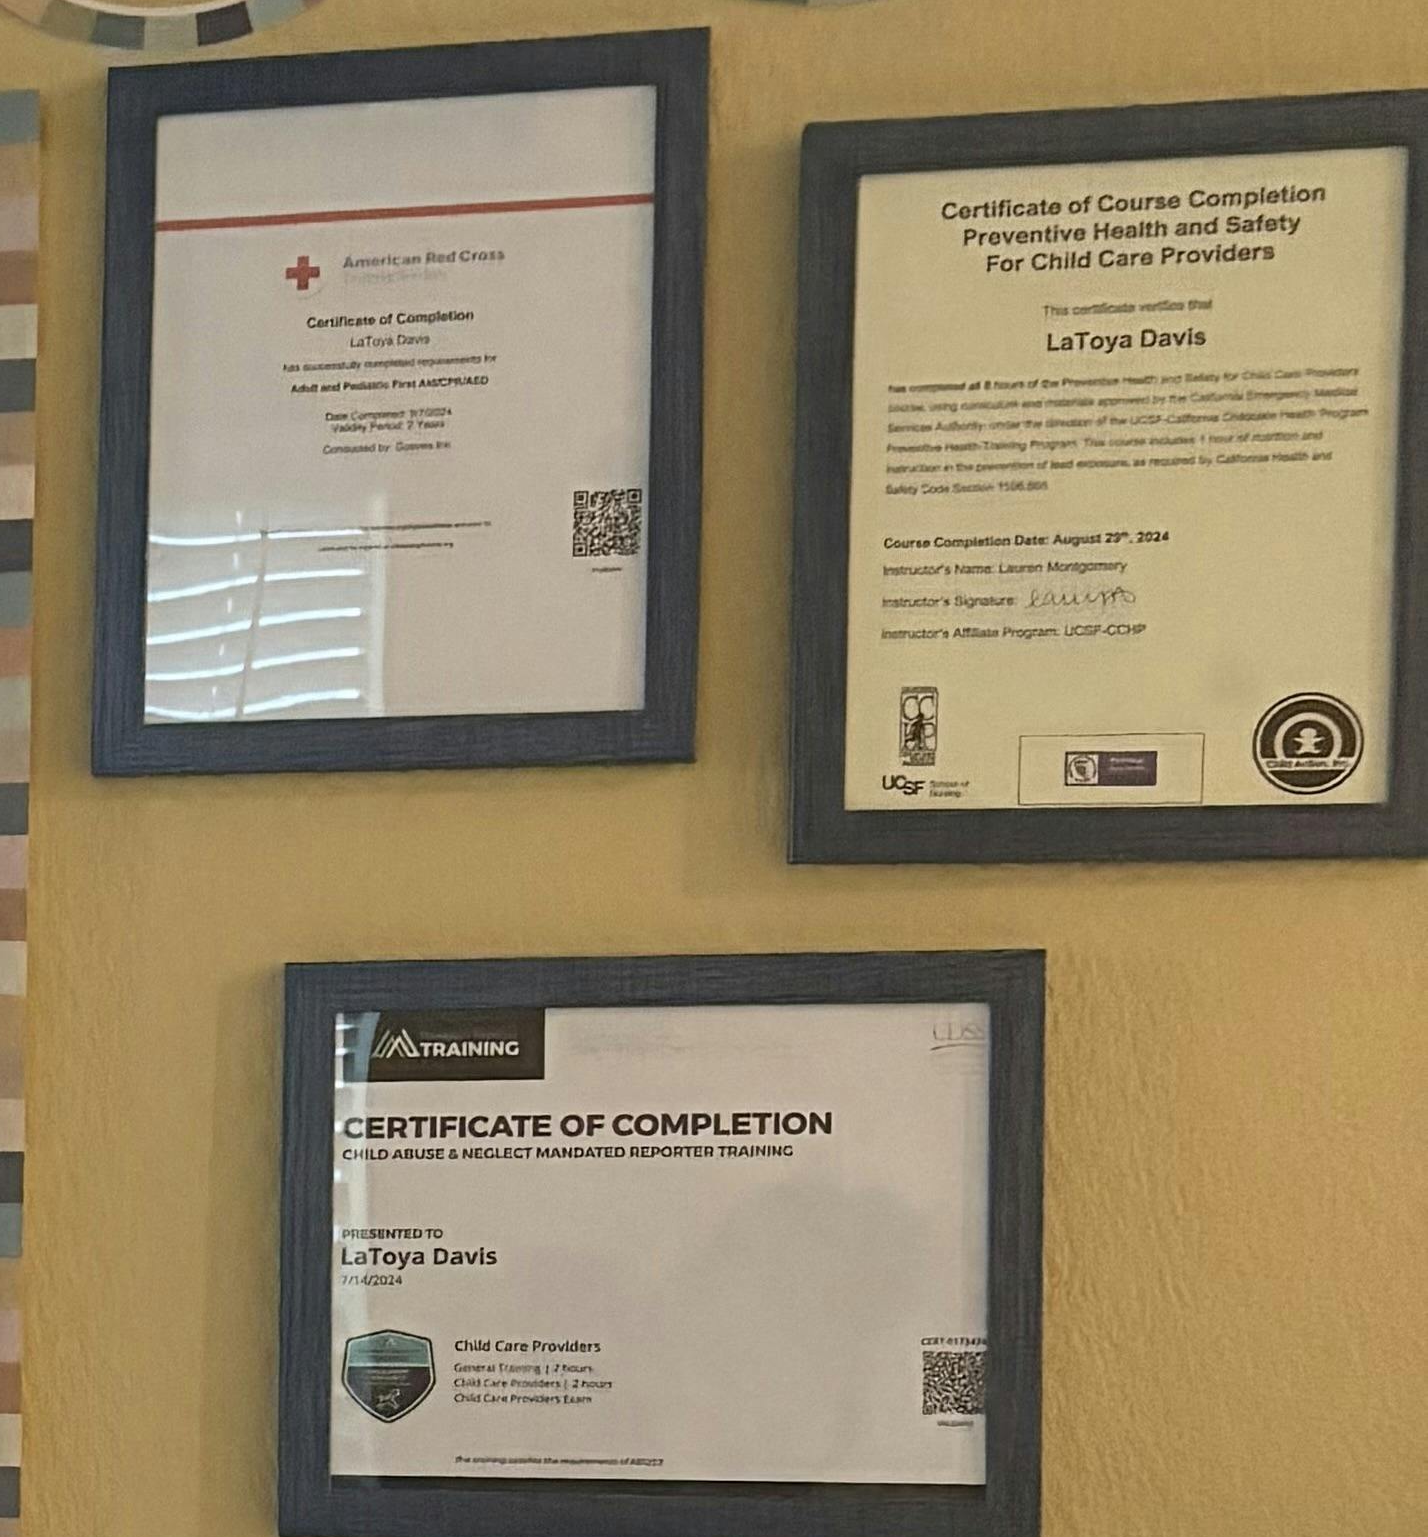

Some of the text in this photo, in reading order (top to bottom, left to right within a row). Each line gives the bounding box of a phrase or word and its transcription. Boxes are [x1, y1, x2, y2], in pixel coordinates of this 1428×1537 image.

[942, 186, 1326, 220] Certificate of Course Completion
[963, 214, 1300, 246] Preventive Health and Safety
[426, 252, 456, 263] Red
[459, 250, 505, 262] Cross
[986, 243, 1274, 272] For Child Care Providers
[307, 311, 474, 328] Certificate of Completion
[1047, 329, 1206, 354] LaToya Davis
[884, 538, 930, 549] Course
[934, 536, 1010, 549] Completion
[1014, 535, 1048, 546] Date:
[1053, 534, 1101, 546] August
[343, 1111, 833, 1139] CERTIFICATE OF COMPLETION
[343, 1145, 794, 1160] CHILD ABUSE & NEGLECT MANDATED REPORTER TRAINING
[342, 1229, 443, 1239] PRESENTED TO
[341, 1248, 498, 1270] LaToya Davis
[455, 1340, 601, 1352] Child Care Providers
